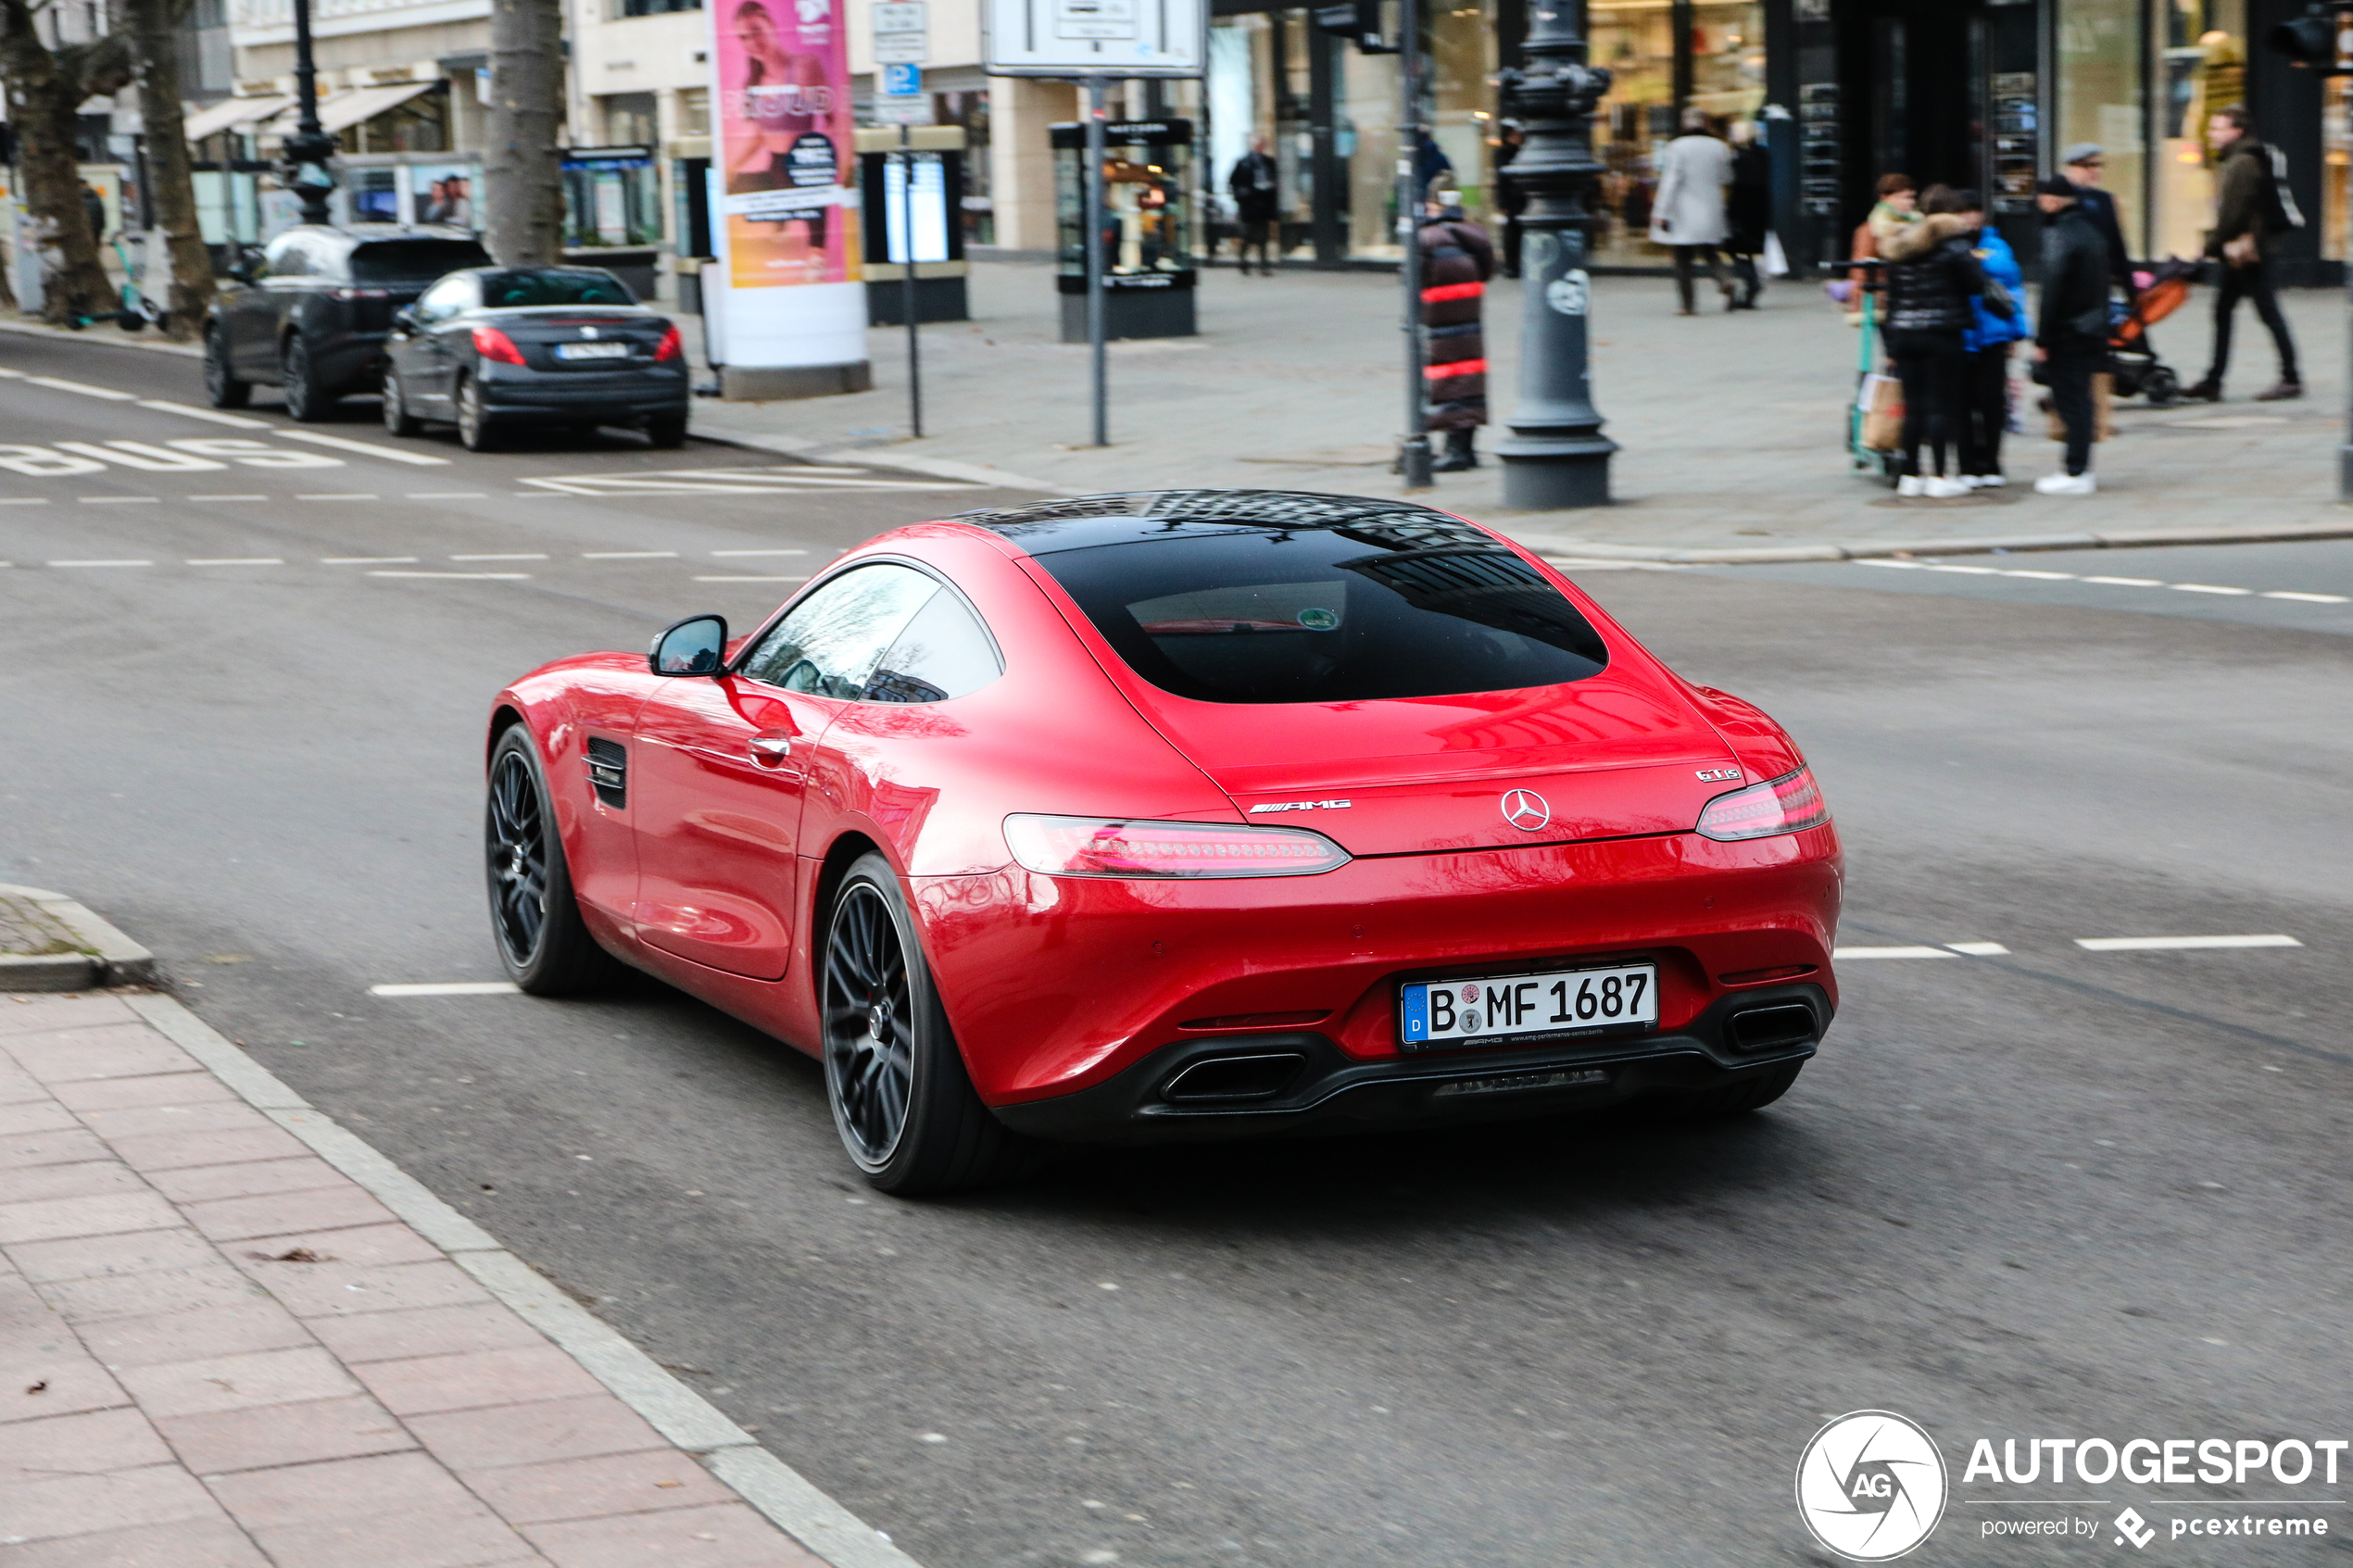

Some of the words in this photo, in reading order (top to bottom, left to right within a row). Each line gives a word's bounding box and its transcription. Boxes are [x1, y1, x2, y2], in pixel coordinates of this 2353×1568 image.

[1282, 799, 1352, 811] AMG
[1430, 990, 1456, 1032] B
[1487, 983, 1539, 1027] MF
[1550, 973, 1648, 1022] 1687
[1412, 1020, 1421, 1032] D
